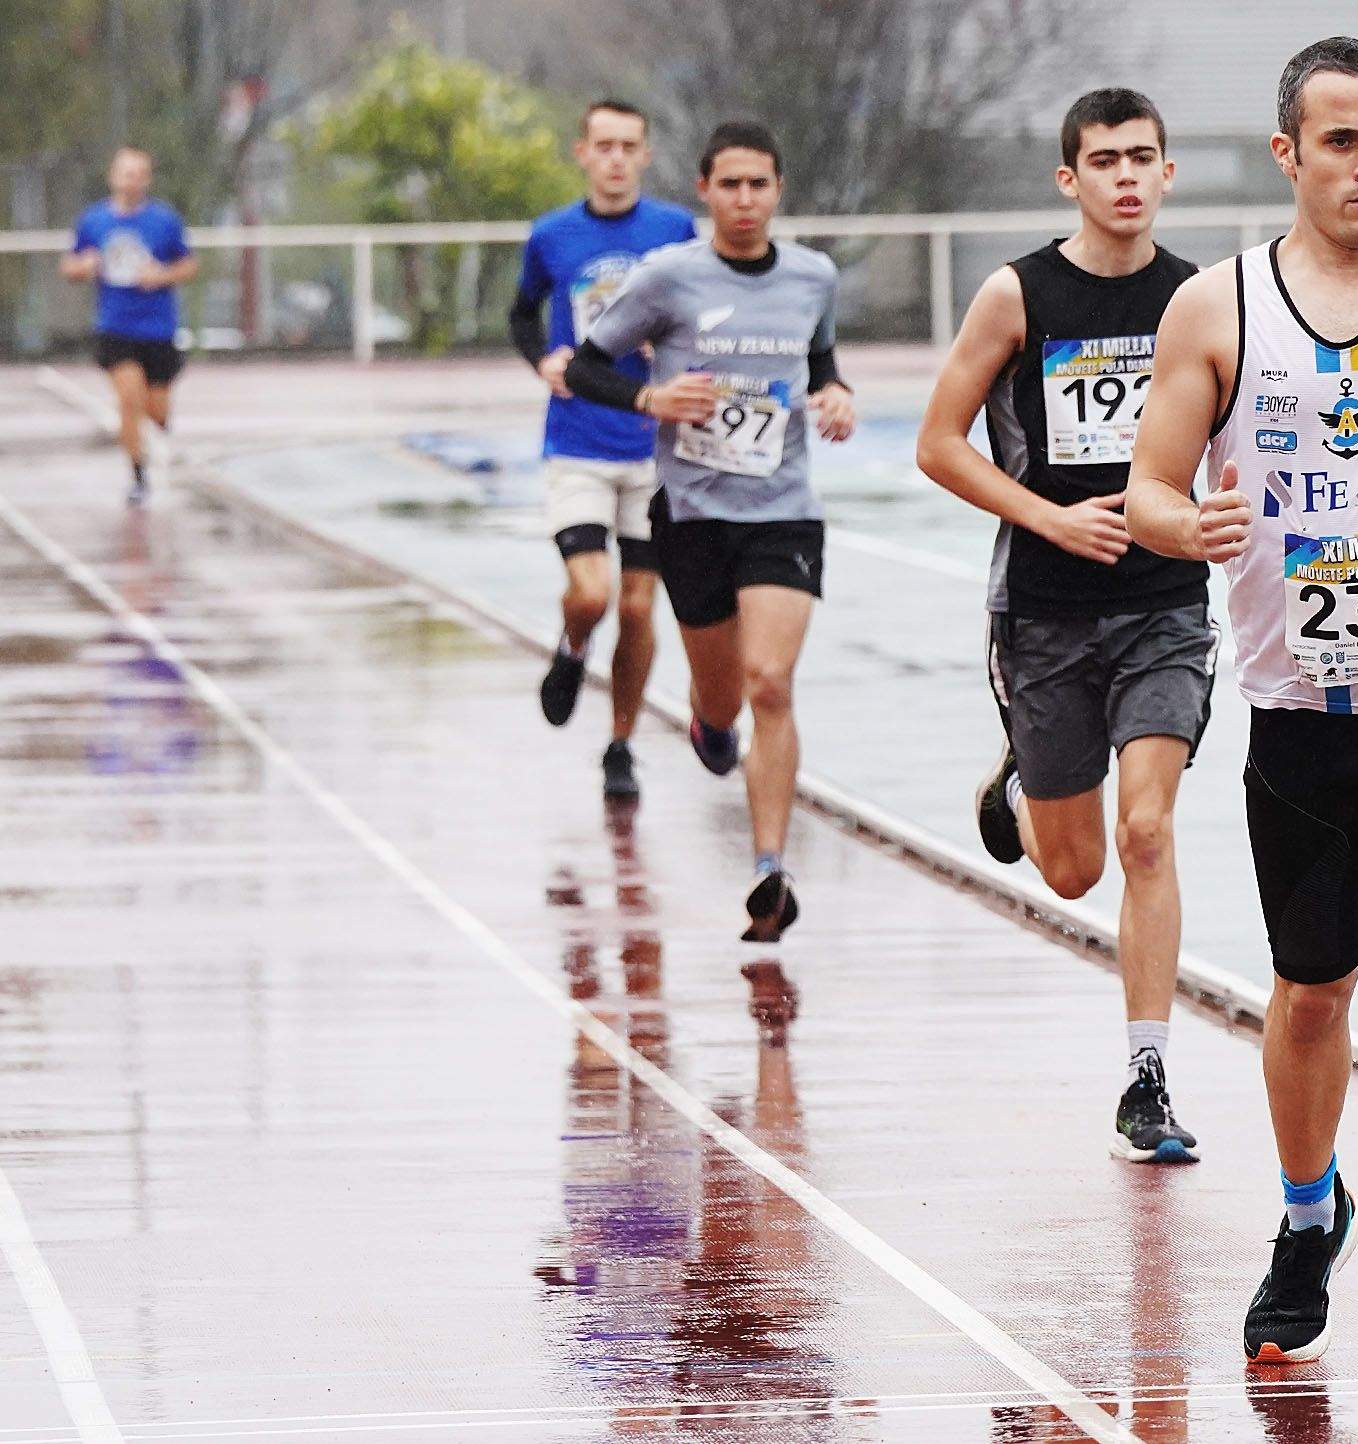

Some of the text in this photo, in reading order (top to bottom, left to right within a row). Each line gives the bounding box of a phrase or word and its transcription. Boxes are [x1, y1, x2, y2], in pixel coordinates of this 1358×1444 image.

[697, 336, 738, 355] NEW
[1081, 336, 1152, 359] XI MILLA
[1301, 471, 1349, 512] FE
[1321, 540, 1344, 563] XI
